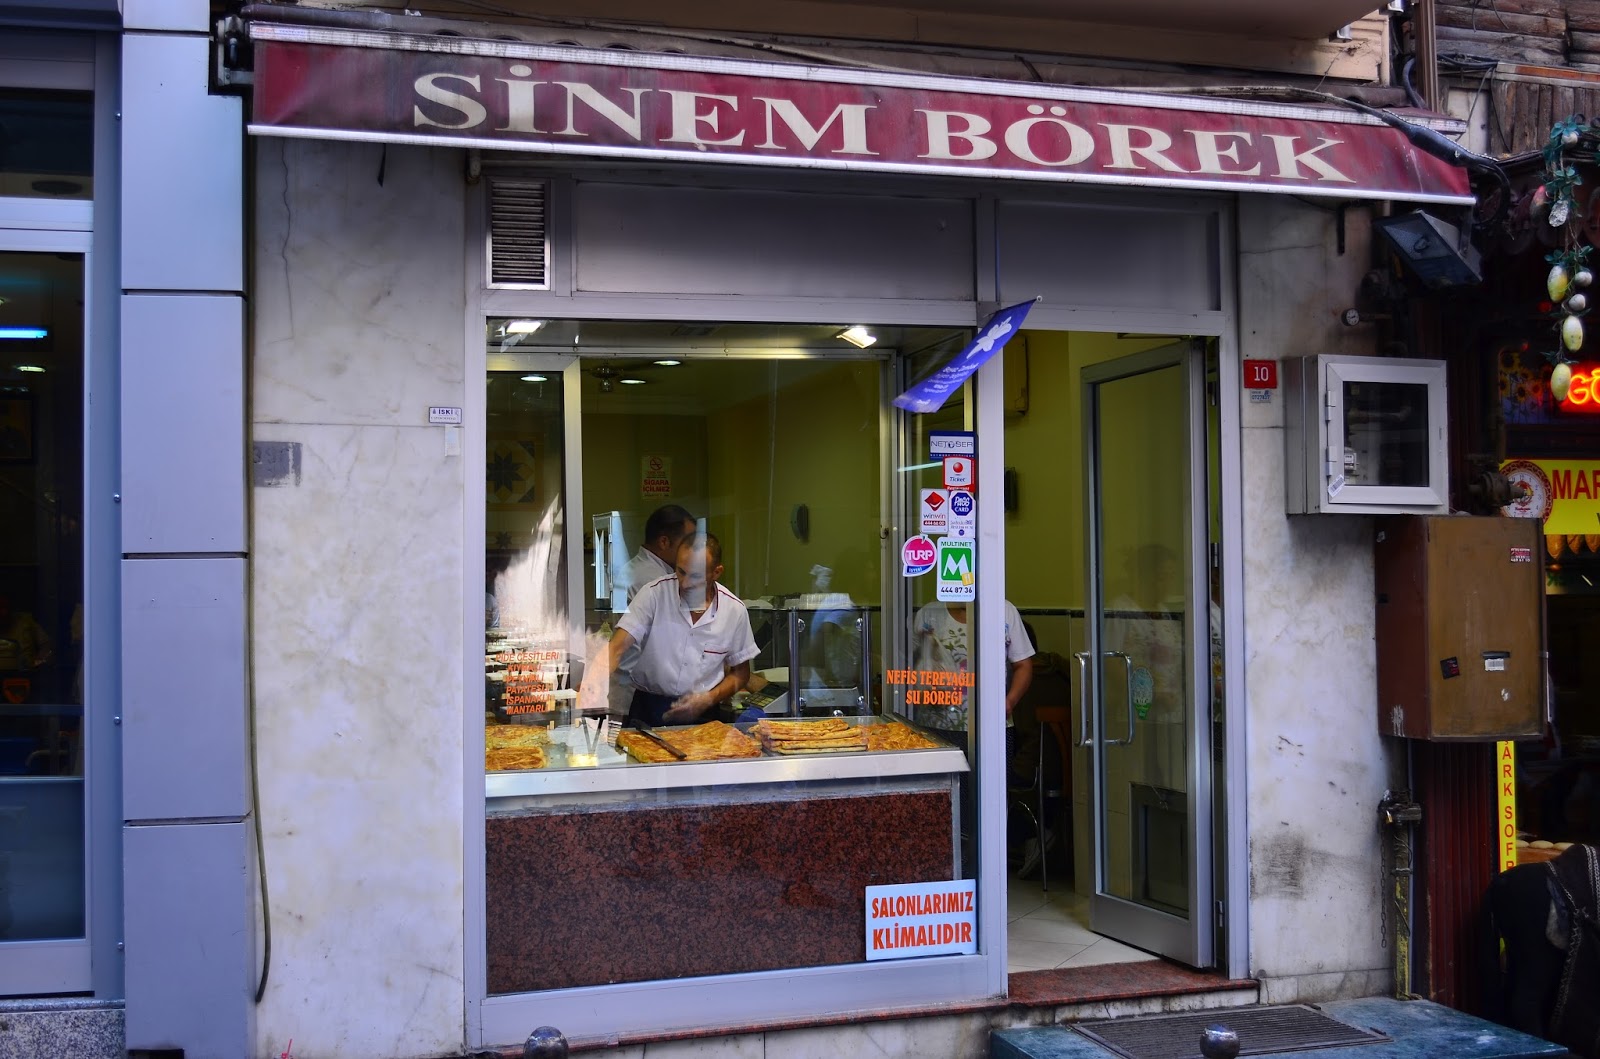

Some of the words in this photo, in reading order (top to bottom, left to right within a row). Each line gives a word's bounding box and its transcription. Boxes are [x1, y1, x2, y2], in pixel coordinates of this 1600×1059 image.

[413, 64, 880, 155] SİNEM
[914, 104, 1357, 183] BÖREK
[1254, 366, 1269, 381] 10
[905, 549, 933, 561] TURP
[886, 666, 918, 685] NEFİS
[919, 667, 975, 687] TEREYAĞLI
[905, 689, 920, 705] SU
[922, 686, 963, 706] BÖREĞİ
[871, 890, 974, 919] SALONLARIMIZ
[872, 921, 972, 950] KLİMALIDIR
